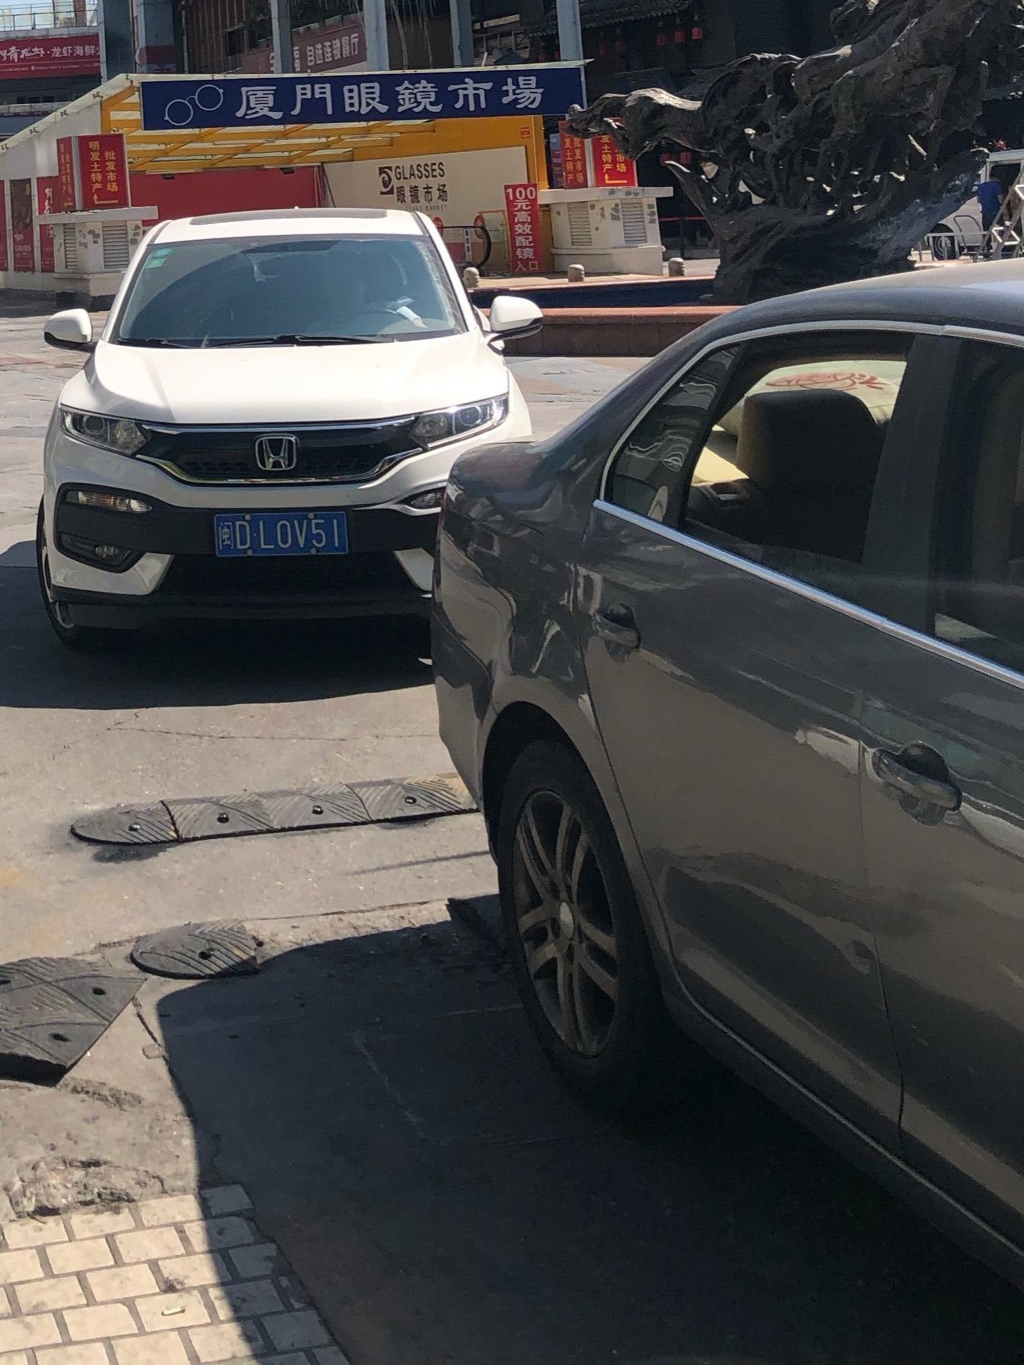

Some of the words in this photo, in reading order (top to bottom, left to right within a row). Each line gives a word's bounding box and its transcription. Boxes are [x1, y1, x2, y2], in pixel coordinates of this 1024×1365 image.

[234, 76, 545, 120] 厦門眼鏡市場
[88, 141, 103, 193] 明发土特产
[104, 150, 119, 193] 批发市场
[394, 162, 445, 181] GLASSES
[395, 184, 448, 205] 眼镜市场
[506, 187, 536, 200] 100
[515, 261, 539, 273] 入口
